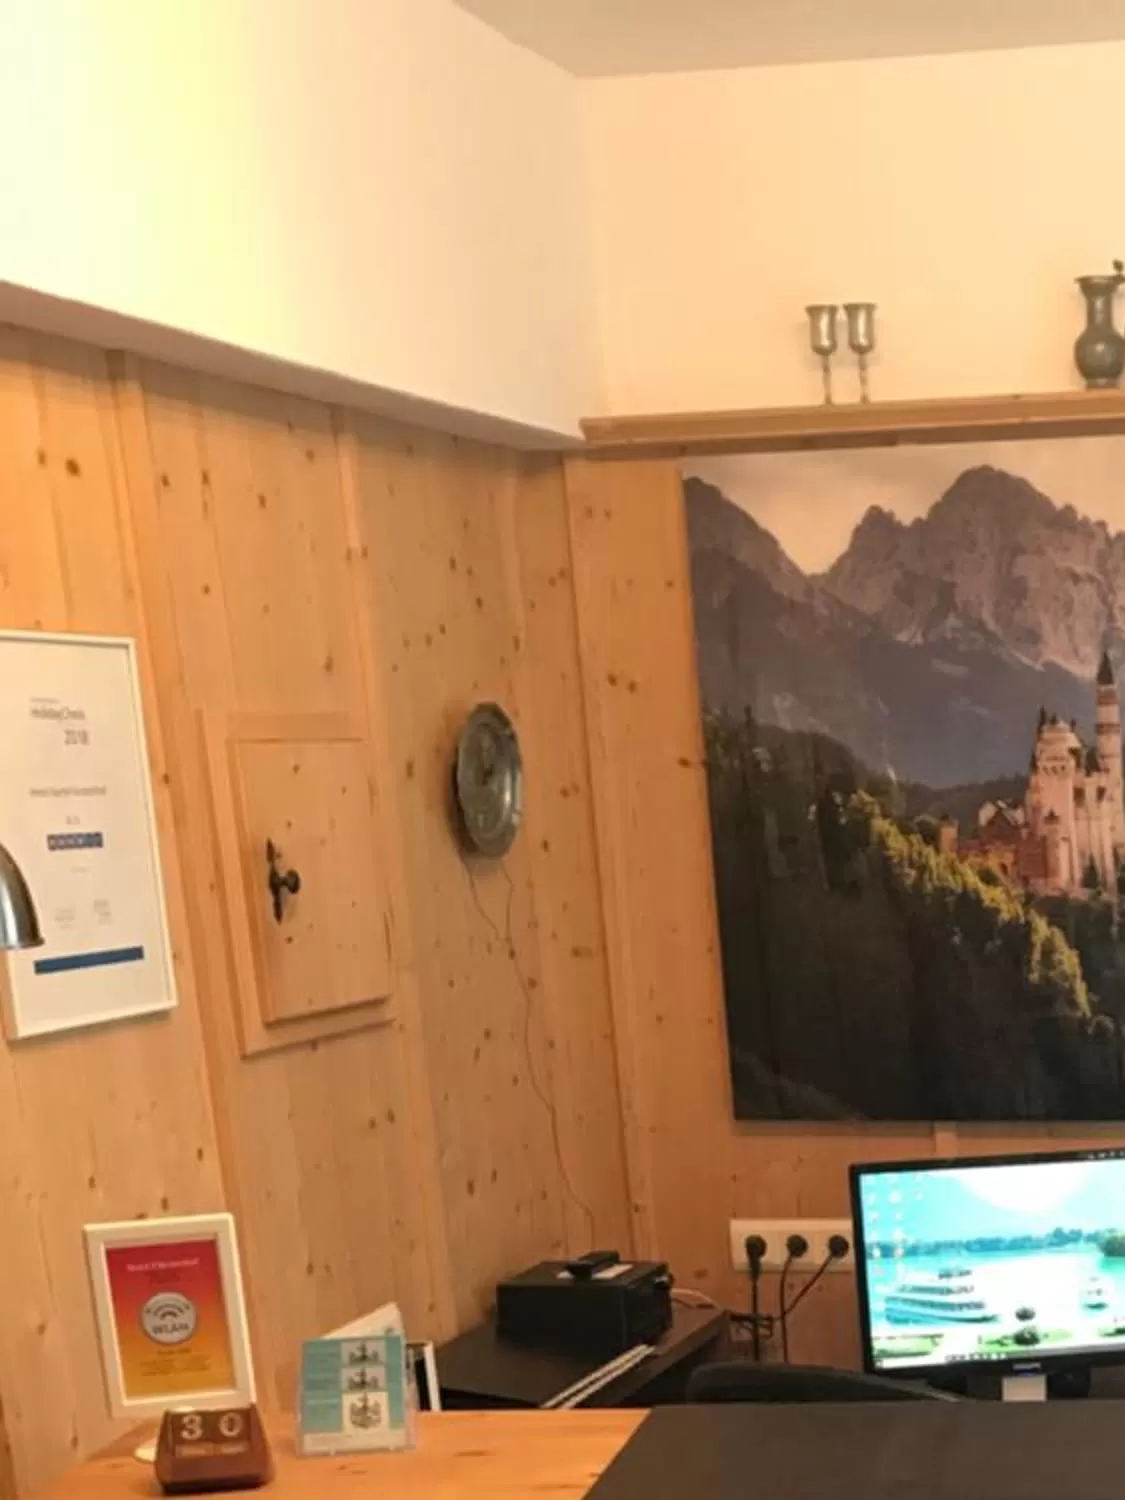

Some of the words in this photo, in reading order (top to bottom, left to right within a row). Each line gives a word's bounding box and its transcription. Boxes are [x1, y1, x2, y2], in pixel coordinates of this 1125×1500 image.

[151, 1323, 190, 1334] WLAN
[180, 1414, 203, 1440] 3
[219, 1411, 243, 1438] 0
